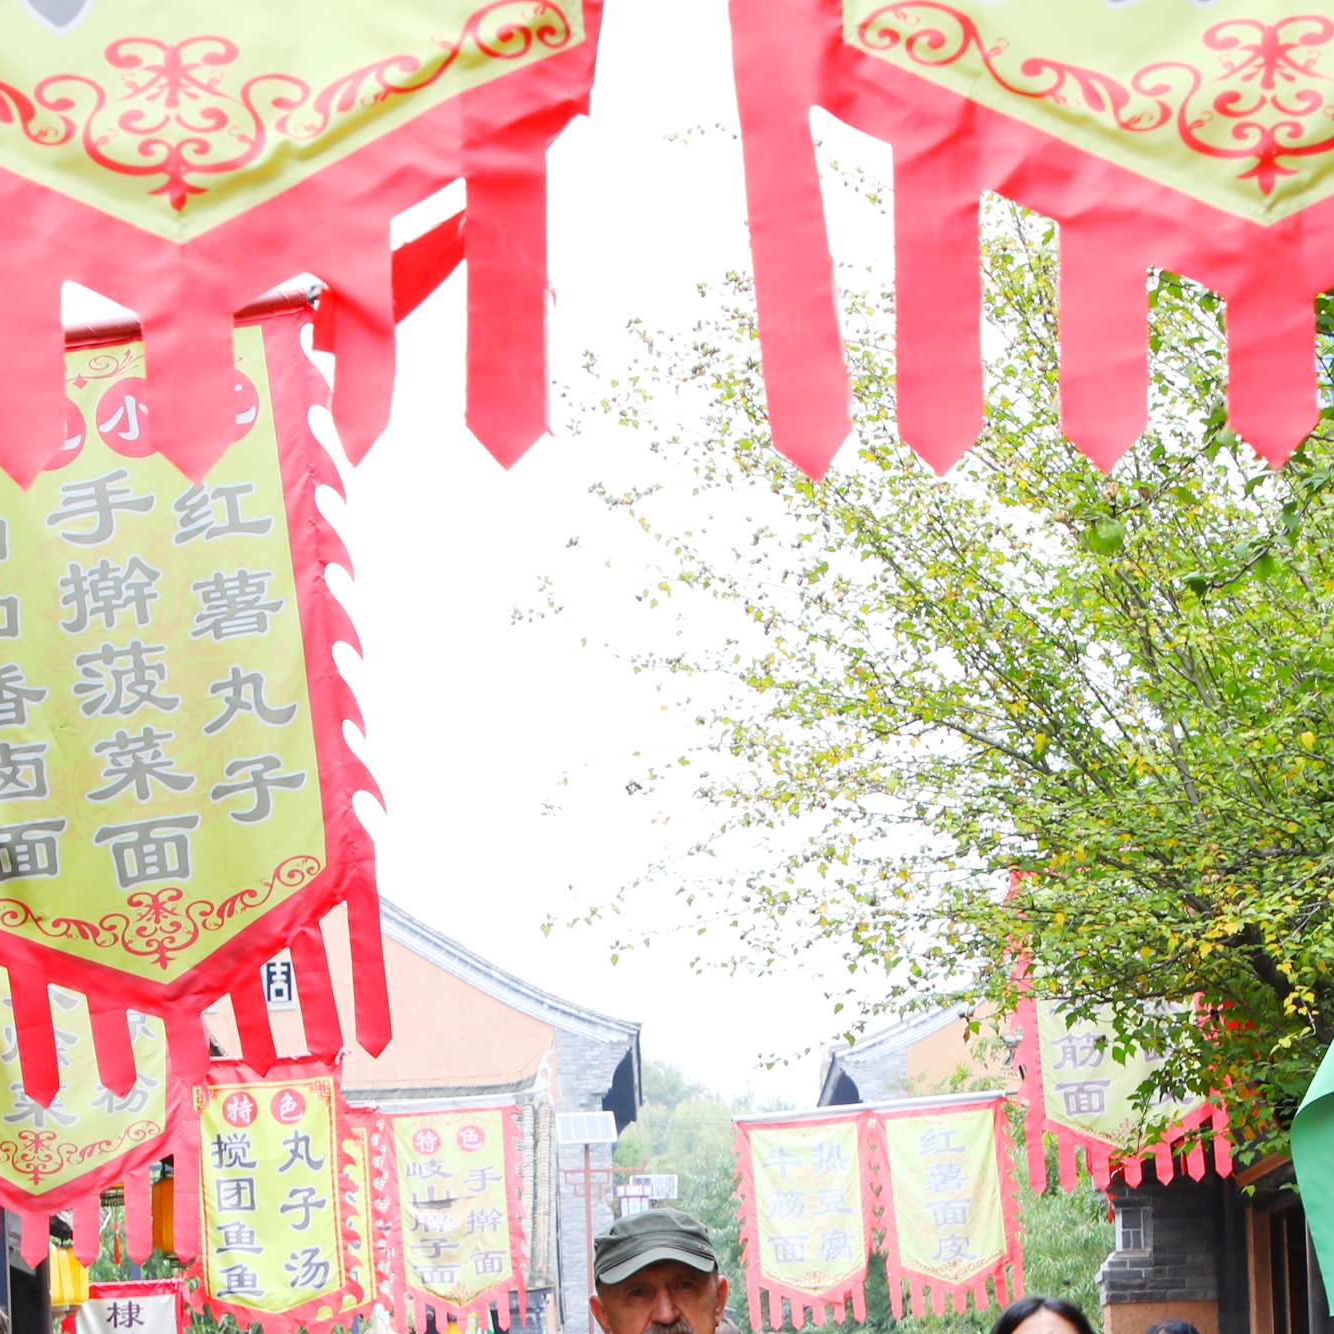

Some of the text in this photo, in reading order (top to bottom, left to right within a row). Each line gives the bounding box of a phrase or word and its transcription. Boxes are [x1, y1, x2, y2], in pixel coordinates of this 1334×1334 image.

[47, 470, 201, 887] 手擀菠菜面
[172, 482, 306, 823] 红薯丸子
[226, 1093, 304, 1124] 特色
[416, 1128, 483, 1153] 特色
[210, 1133, 266, 1298] 搅团鱼鱼
[277, 1130, 330, 1289] 丸子汤
[462, 1166, 508, 1276] 手擀面
[761, 1146, 810, 1264] 牛筋面
[808, 1142, 856, 1262] 热豆腐
[918, 1128, 978, 1262] 红薯面皮
